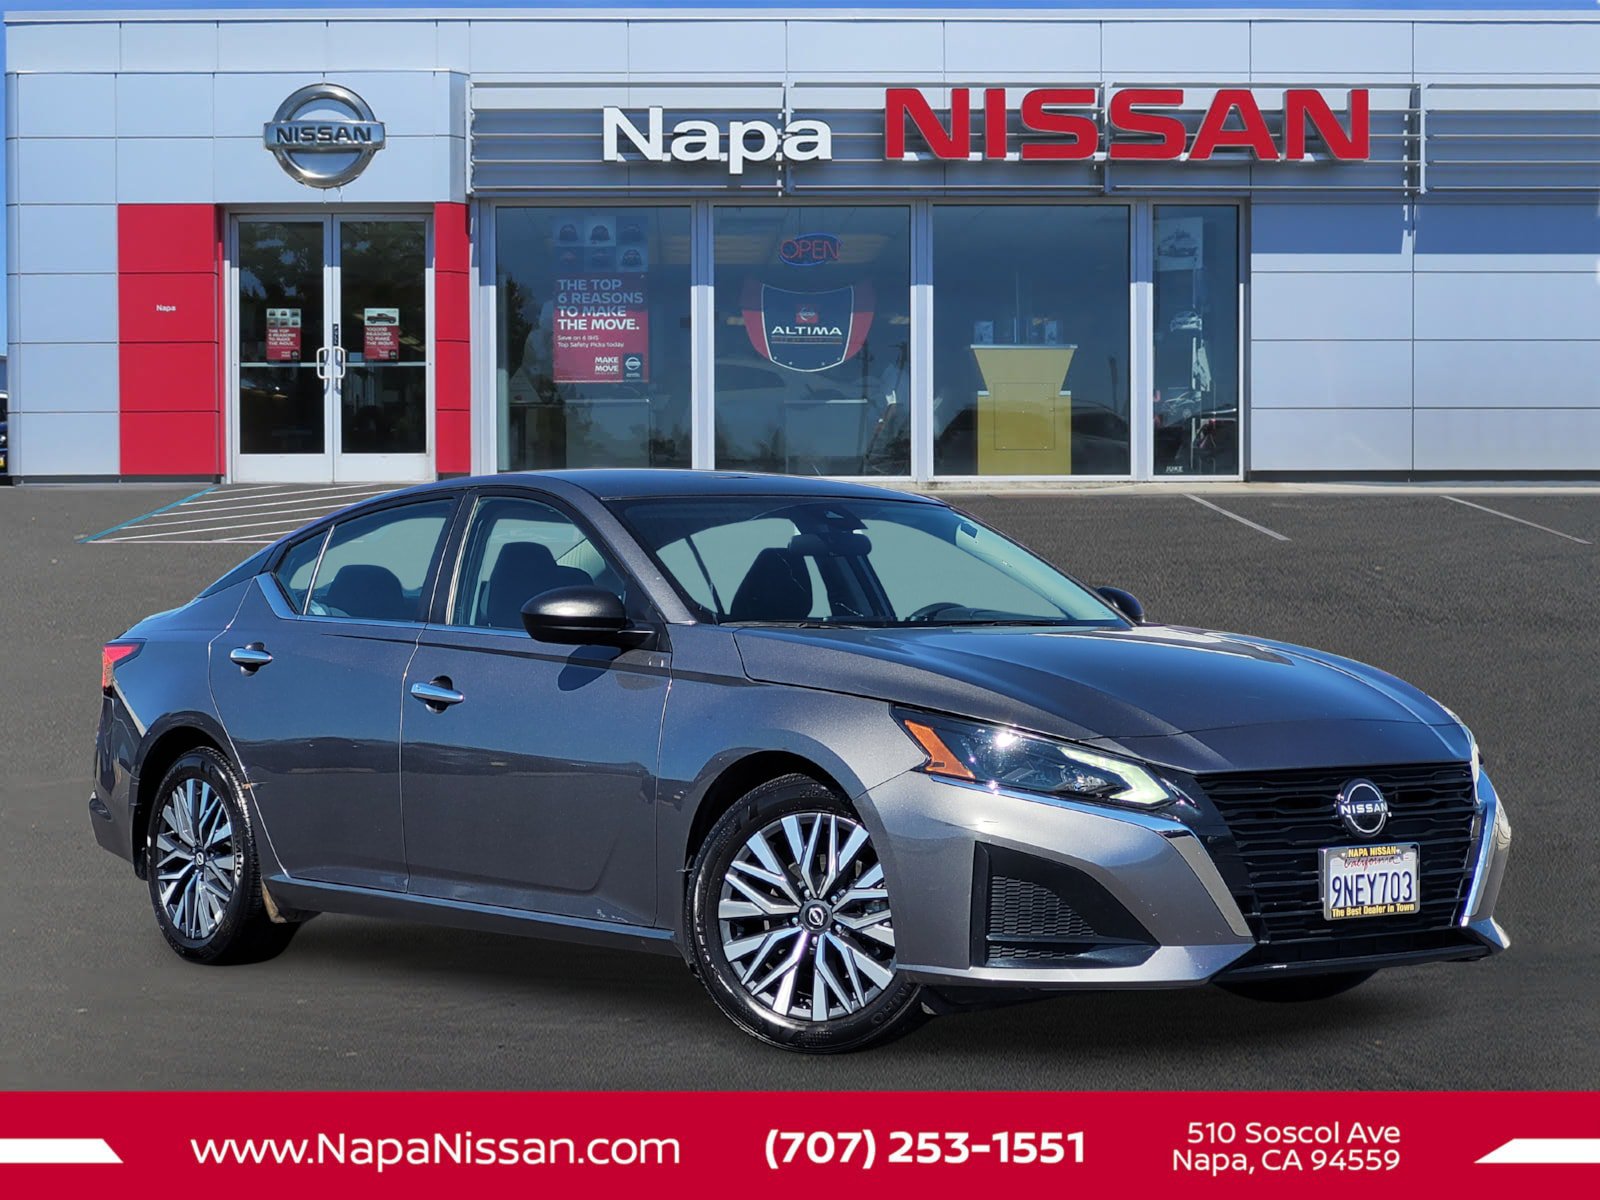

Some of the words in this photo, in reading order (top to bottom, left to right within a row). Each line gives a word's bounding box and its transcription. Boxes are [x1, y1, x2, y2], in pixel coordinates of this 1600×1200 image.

[276, 126, 372, 143] NISSAN
[602, 106, 833, 175] Napa
[885, 87, 1370, 162] NISSAN
[780, 240, 841, 261] OPEN
[557, 279, 588, 291] THE
[590, 279, 622, 291] TOP
[558, 292, 568, 304] 6
[571, 292, 644, 304] REASONS
[156, 304, 177, 312] Napa
[557, 305, 579, 317] TO
[582, 305, 627, 317] MAKE
[557, 318, 588, 330] THE
[590, 318, 640, 330] MOVE.
[771, 326, 843, 336] ALTIMA
[594, 356, 619, 364] MAKE
[594, 365, 619, 373] MOVE
[1340, 803, 1388, 814] NISSAN
[1348, 848, 1368, 858] NAPA
[1369, 846, 1397, 856] NISSAN
[1332, 871, 1412, 907] 9NEY703
[1332, 907, 1345, 918] The
[1346, 906, 1362, 916] Best
[1363, 904, 1386, 915] Dealer
[1387, 904, 1395, 912] in
[1396, 902, 1415, 912] Town
